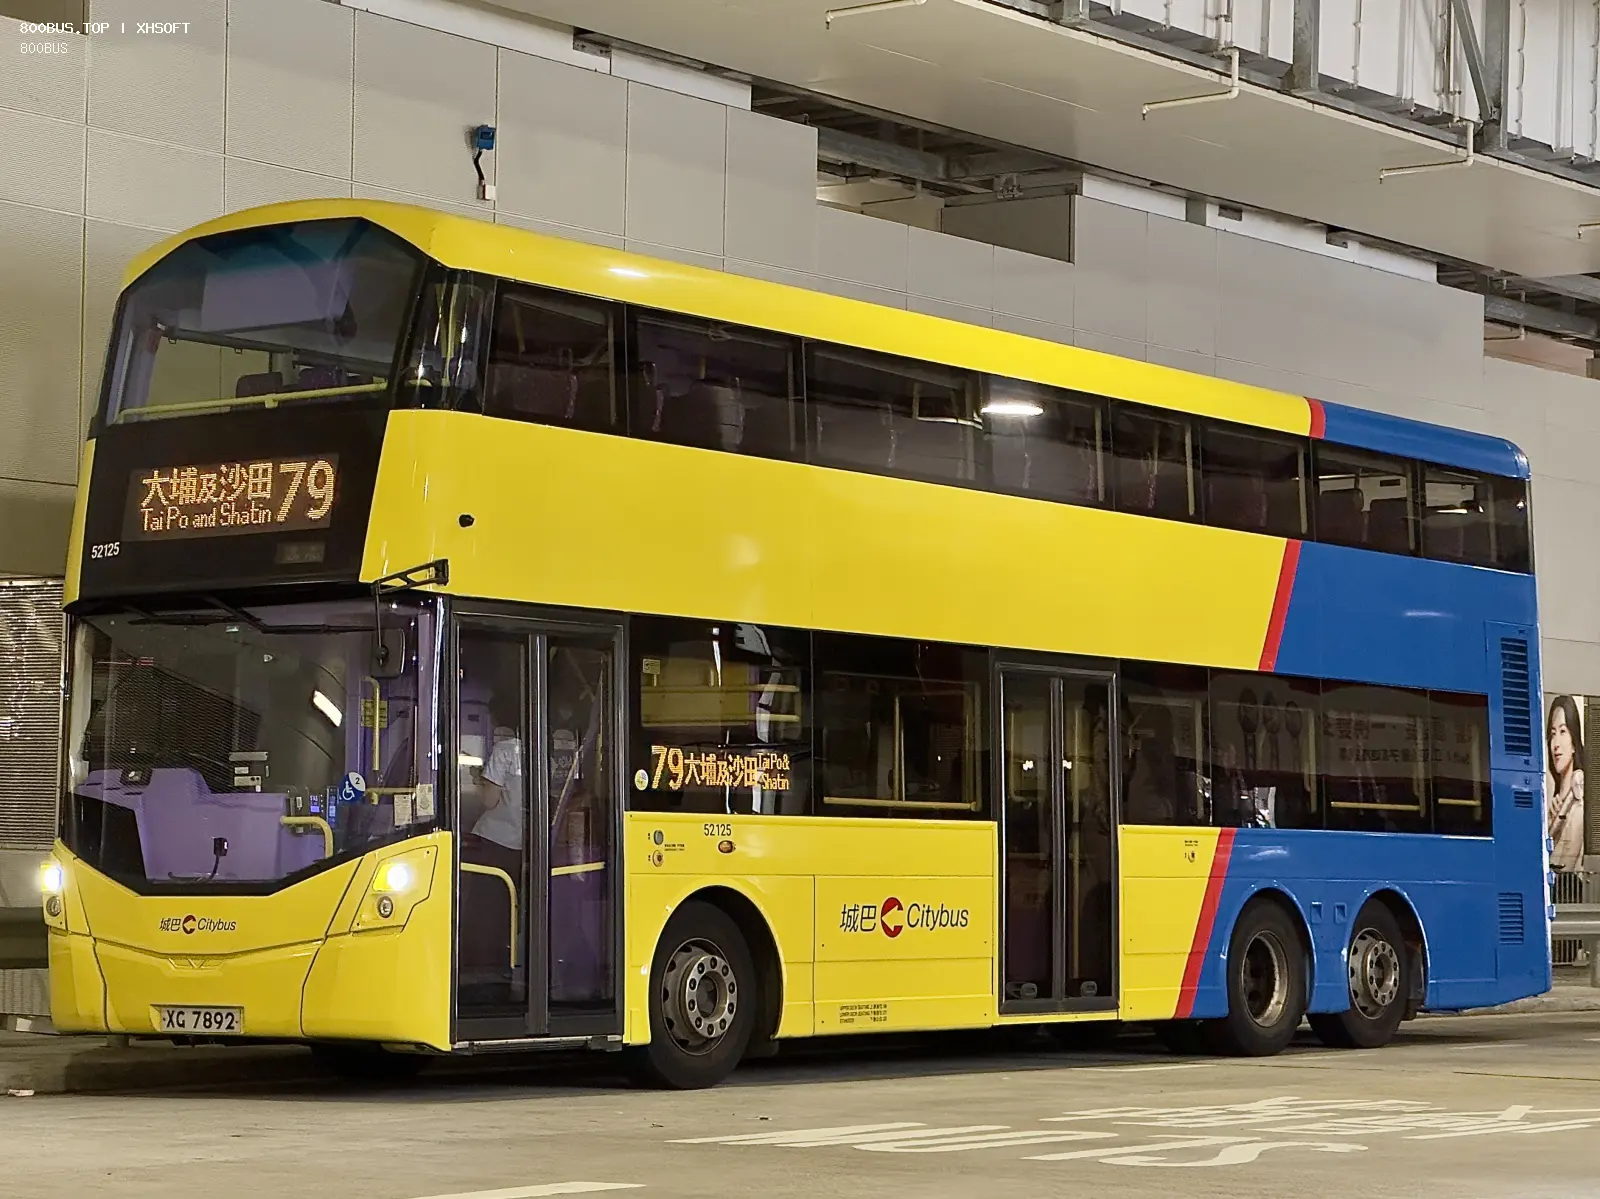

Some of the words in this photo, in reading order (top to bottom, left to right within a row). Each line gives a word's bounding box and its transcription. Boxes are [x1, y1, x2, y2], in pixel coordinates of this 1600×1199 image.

[140, 462, 273, 508] 大埔及沙田
[276, 460, 336, 523] 79
[140, 507, 164, 532] Tai
[166, 506, 189, 530] Po
[192, 507, 217, 529] and
[219, 501, 272, 527] Shatin
[91, 542, 120, 559] 52125
[651, 745, 684, 790] 79
[684, 752, 760, 787] 大埔及沙田
[355, 777, 360, 785] 2
[761, 772, 790, 790] Shatin
[704, 823, 732, 836] 52125
[159, 917, 182, 932] 城巴
[197, 918, 237, 932] Citybus
[839, 903, 877, 933] 城巴
[906, 903, 969, 931] Citybus
[166, 1009, 186, 1028] XG
[192, 1010, 235, 1030] 7892
[666, 1122, 1369, 1168] SLOW
